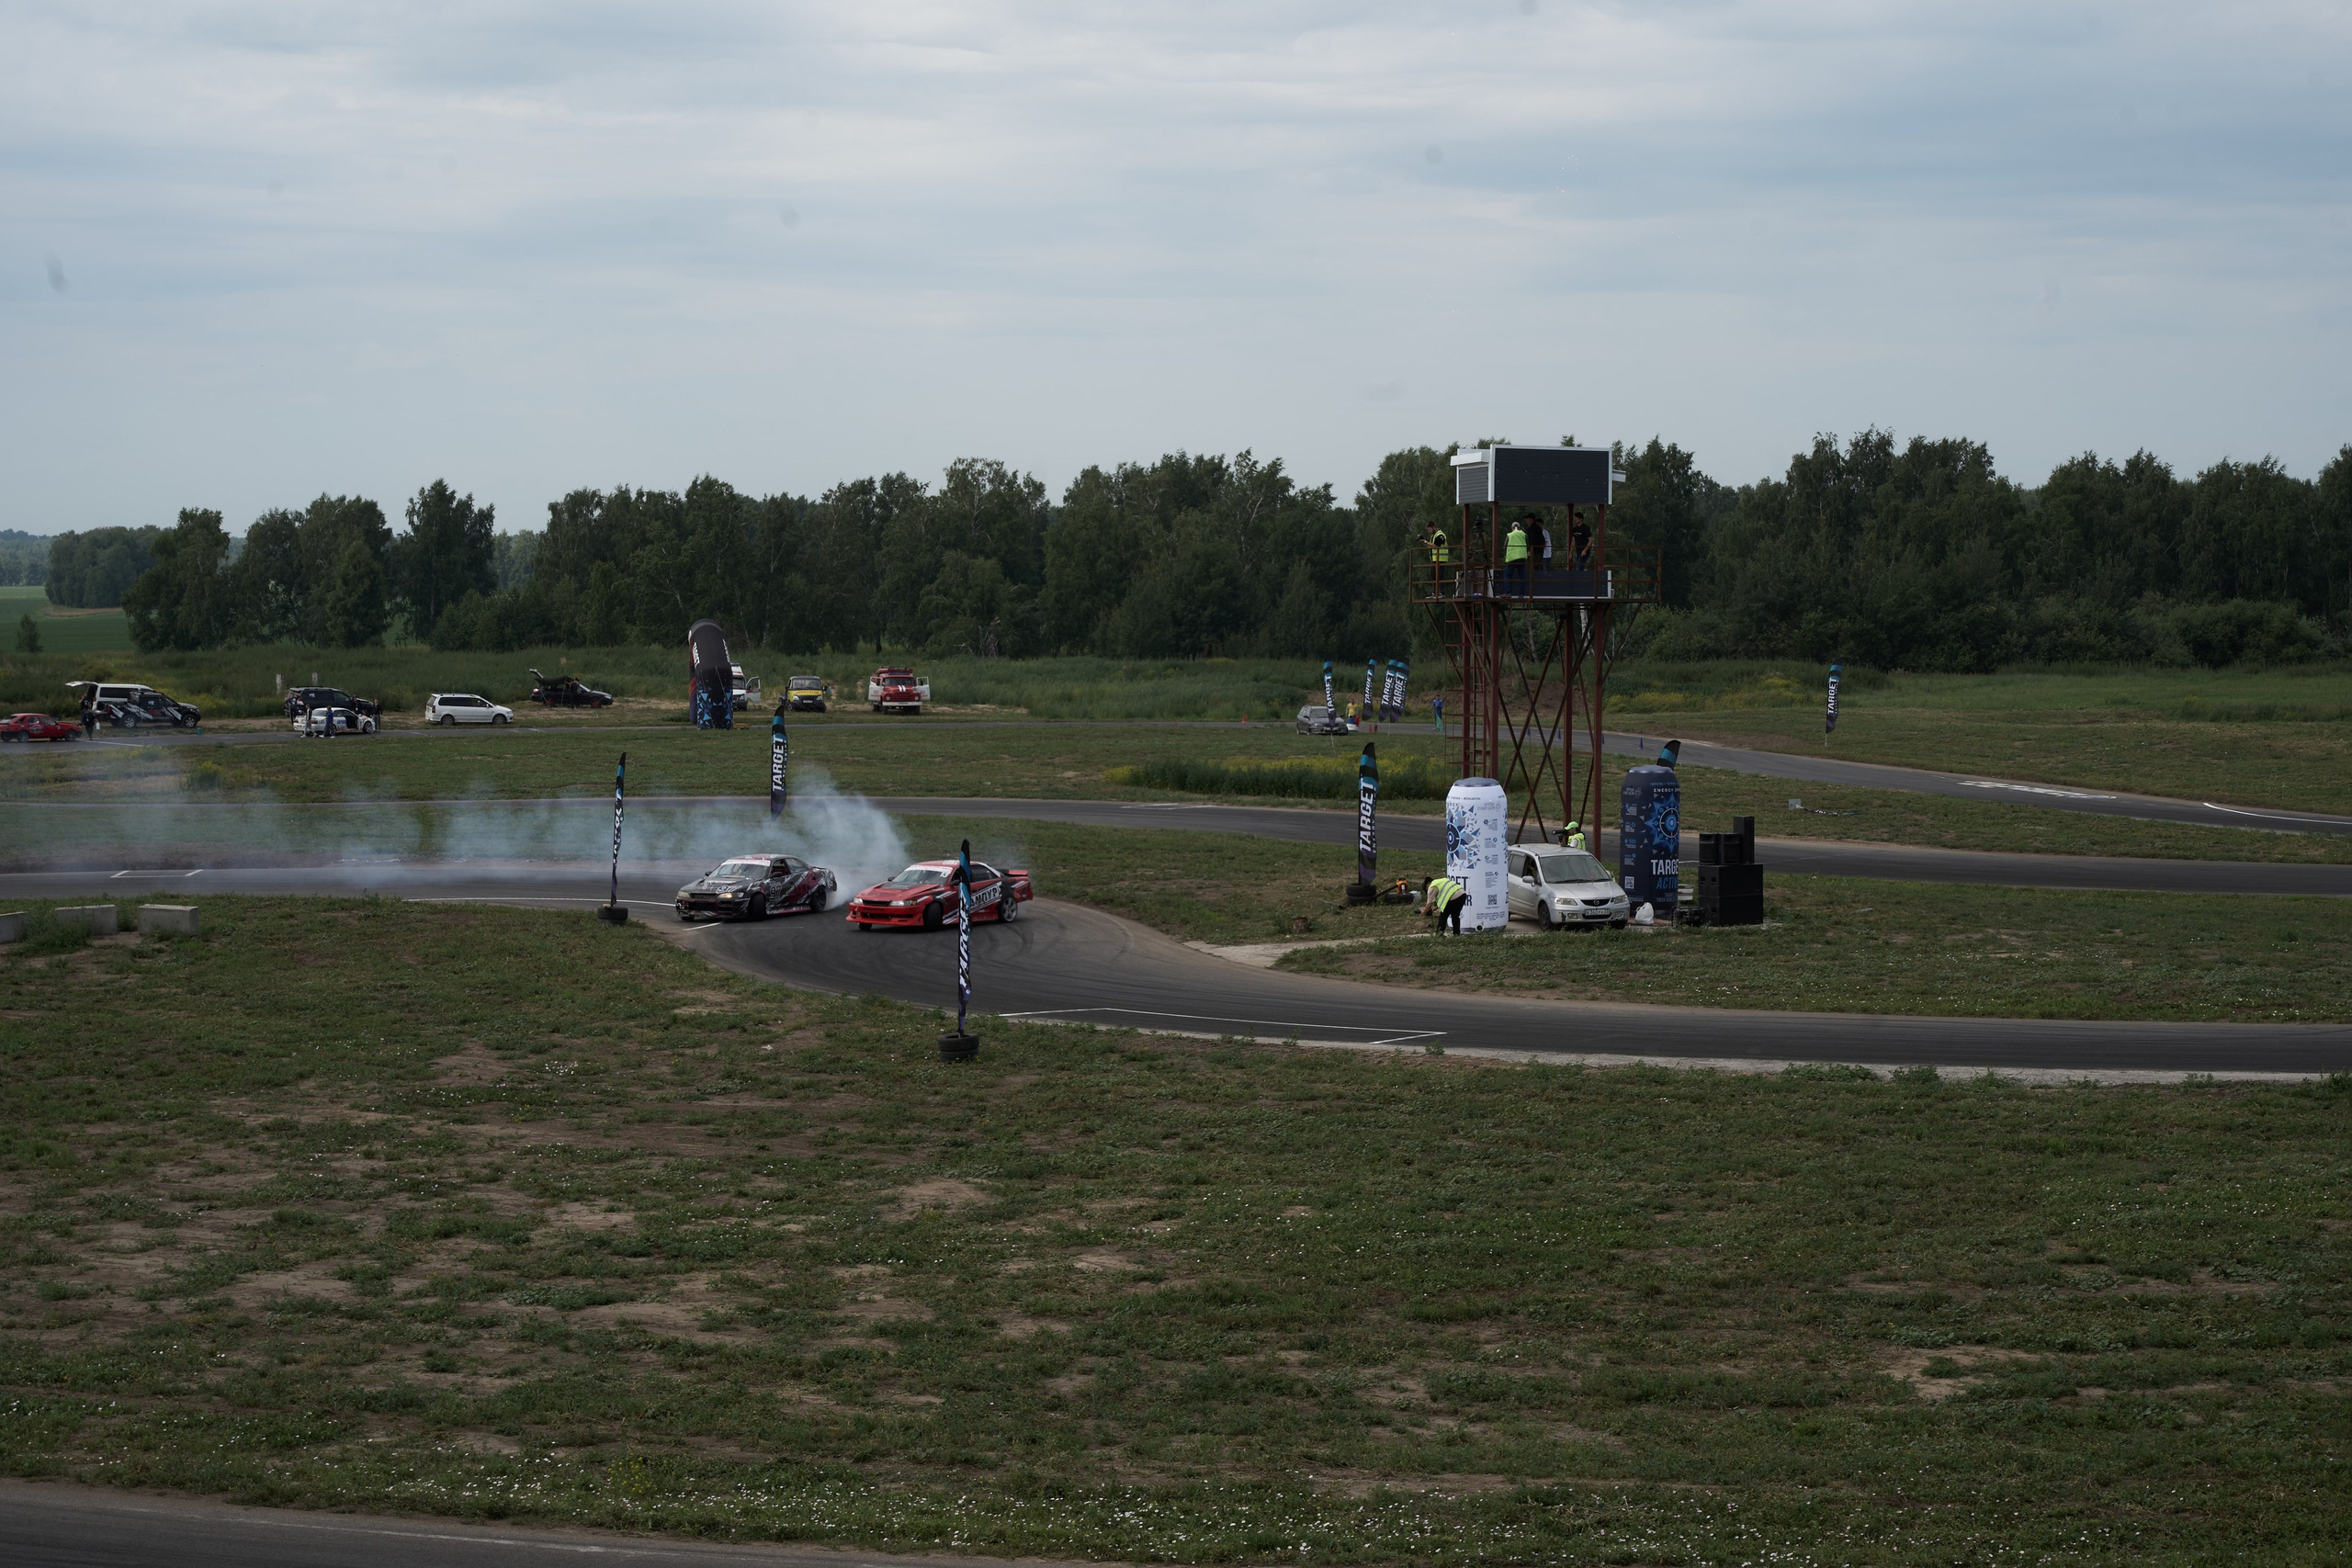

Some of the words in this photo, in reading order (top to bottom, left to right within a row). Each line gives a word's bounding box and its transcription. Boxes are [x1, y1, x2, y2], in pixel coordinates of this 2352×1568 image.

[1381, 671, 1394, 705] TARGET
[1393, 671, 1405, 707] TARGET
[1827, 677, 1837, 715] TARGET
[772, 734, 785, 792] TARGET
[1360, 778, 1374, 852] TARGET
